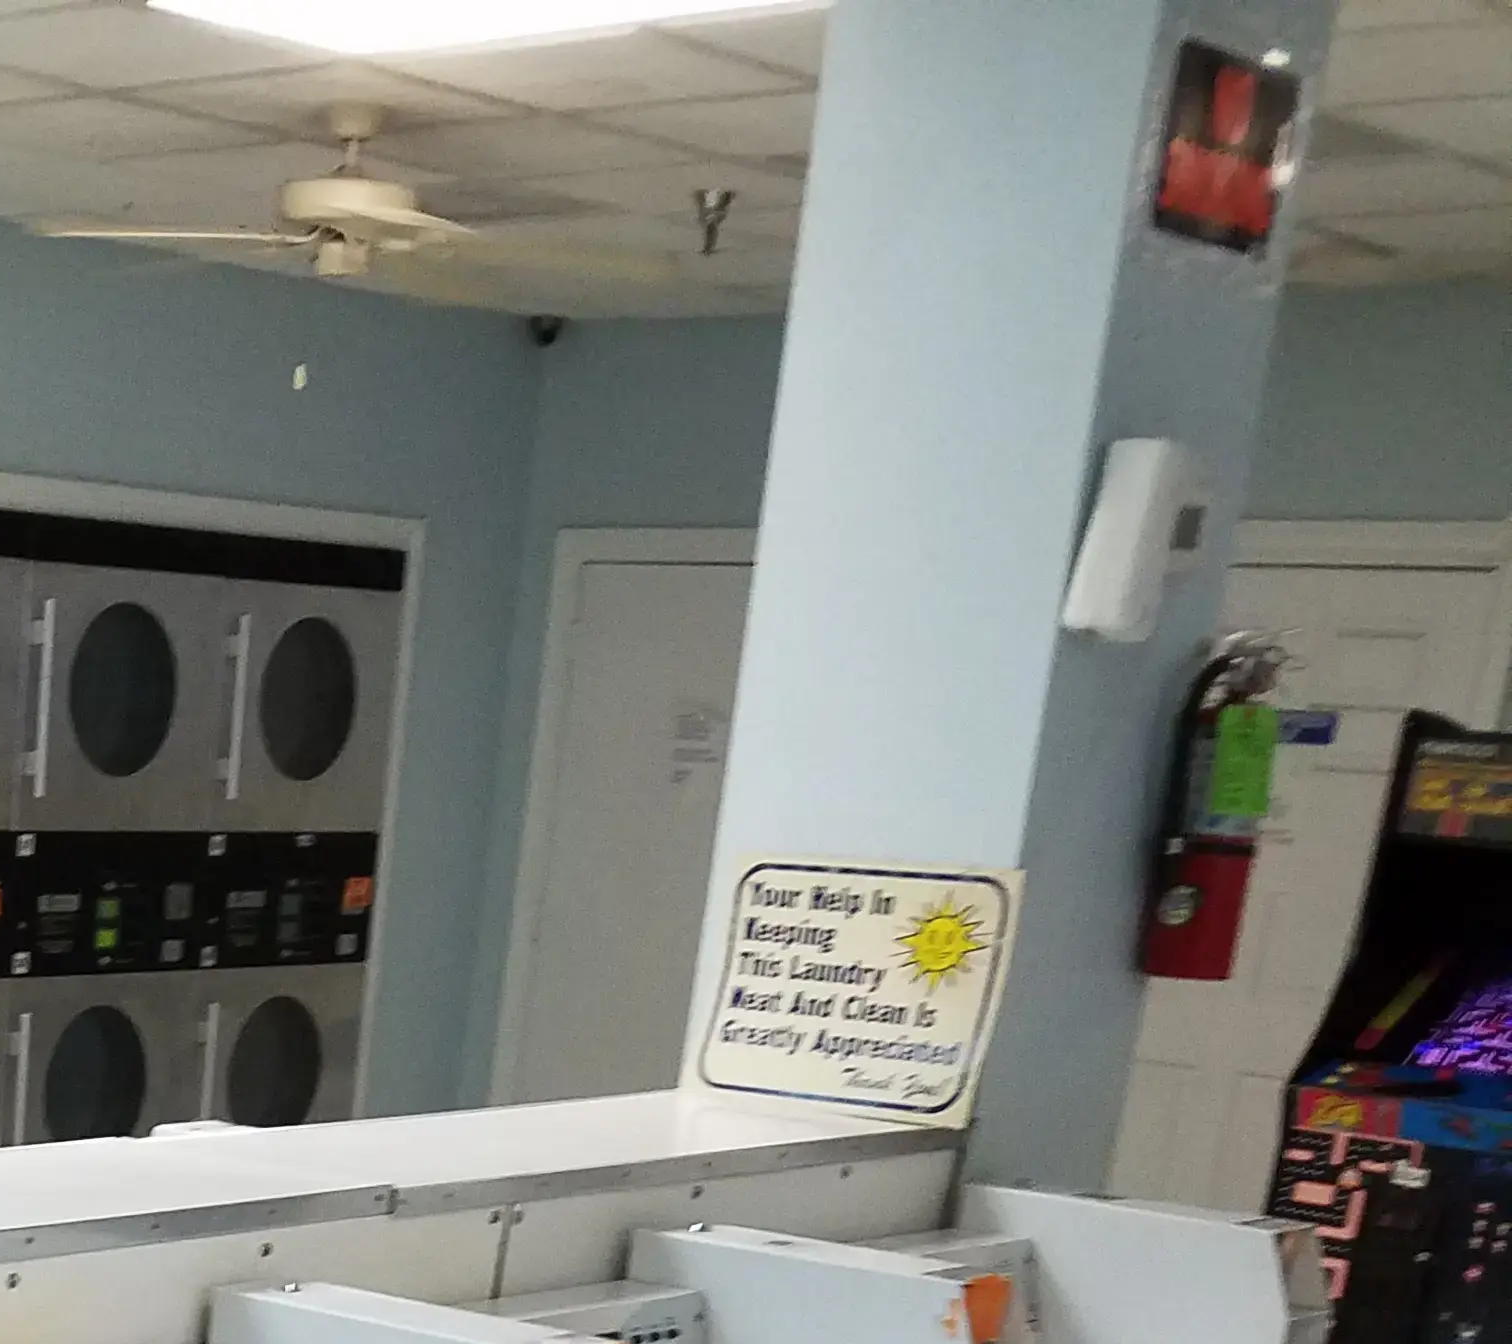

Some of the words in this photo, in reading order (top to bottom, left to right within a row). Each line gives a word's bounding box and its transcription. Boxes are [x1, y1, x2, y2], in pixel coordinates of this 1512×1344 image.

[749, 881, 804, 908] Your
[808, 885, 865, 919] Help
[870, 889, 898, 915] In
[743, 916, 837, 953] Keeping
[737, 951, 783, 978] This
[788, 955, 888, 993] Laundry
[729, 985, 784, 1013] Neat
[787, 990, 838, 1018] And
[841, 995, 909, 1025] Clean
[913, 1001, 938, 1028] Is
[720, 1019, 808, 1055] Greatly
